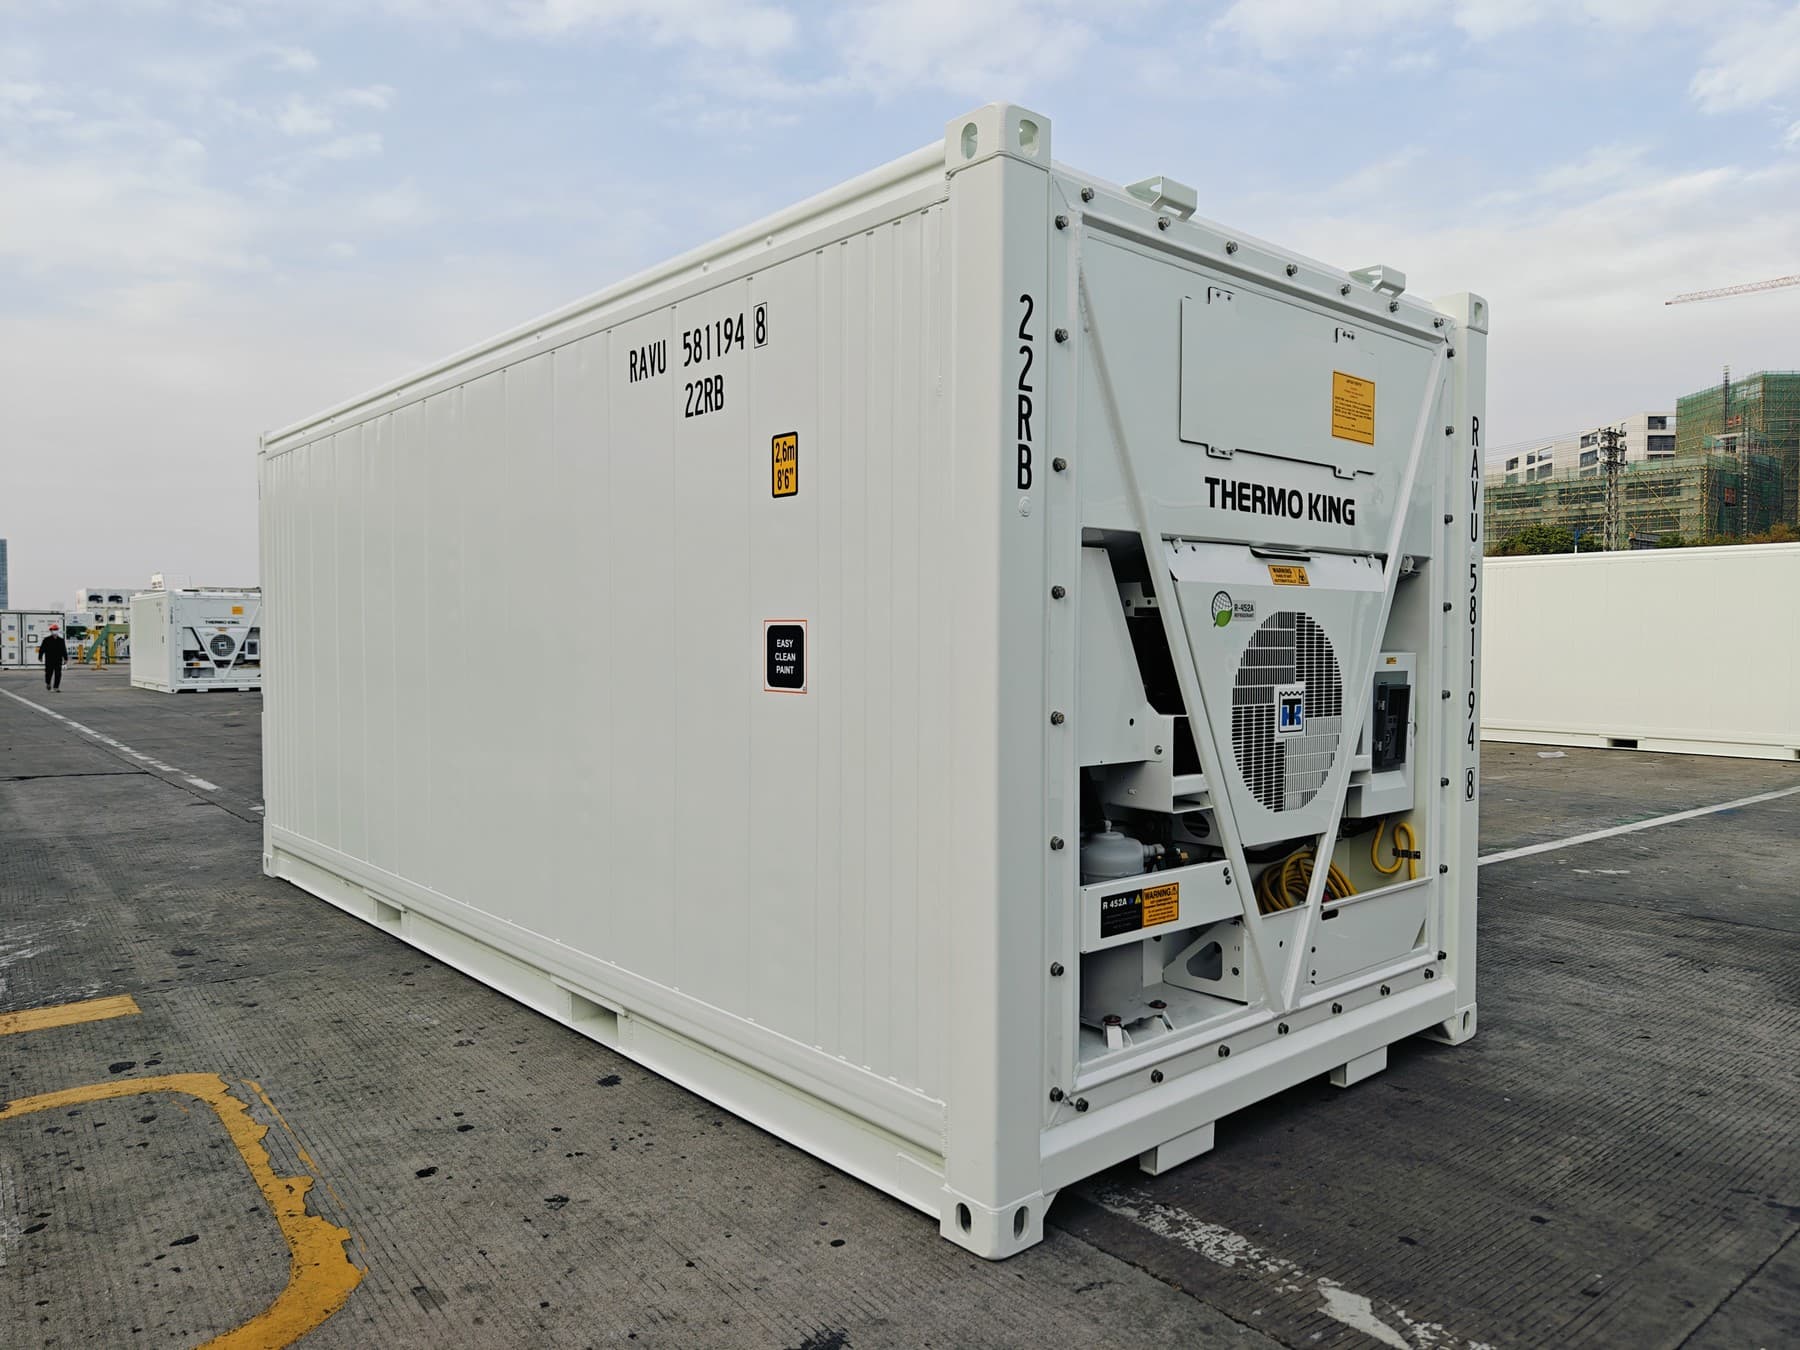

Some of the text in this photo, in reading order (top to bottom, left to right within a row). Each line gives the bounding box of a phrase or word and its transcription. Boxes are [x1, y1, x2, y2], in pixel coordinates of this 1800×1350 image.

[629, 306, 766, 383] RAVU 581194 8
[684, 374, 725, 418] 22RB
[1016, 293, 1034, 490] 22RB
[775, 440, 795, 467] 2,6m
[1204, 476, 1355, 526] THERMO KING
[1466, 415, 1480, 799] RAVU 581194 8
[776, 638, 793, 648] EASY
[774, 652, 796, 662] CLEAN
[776, 665, 795, 674] PAINT
[1102, 897, 1128, 911] R 452A
[1144, 887, 1171, 900] WARNING
